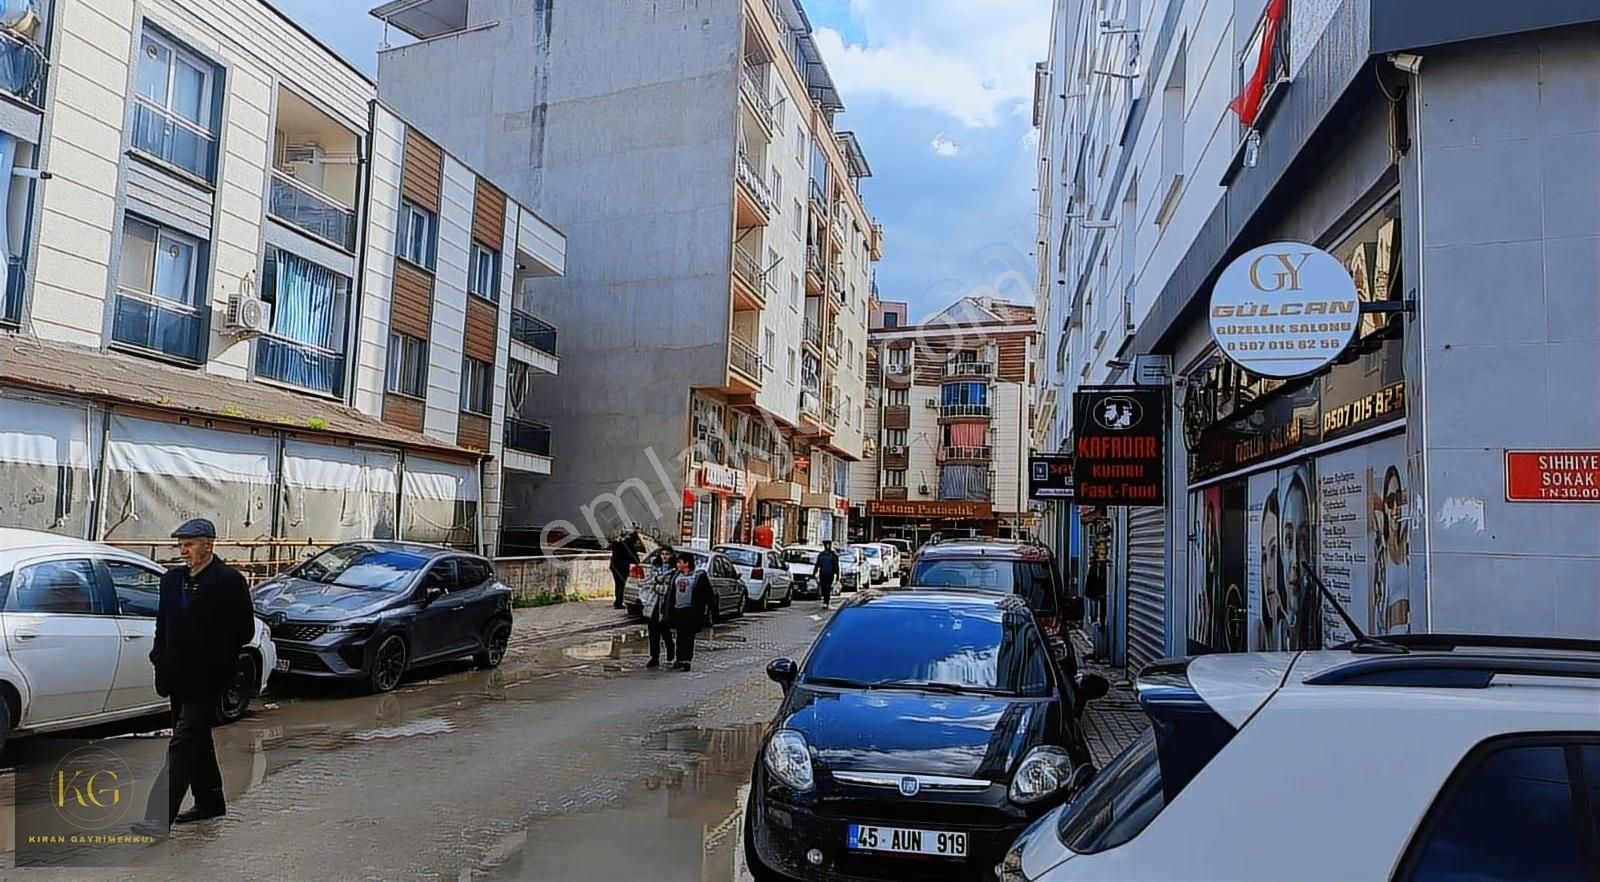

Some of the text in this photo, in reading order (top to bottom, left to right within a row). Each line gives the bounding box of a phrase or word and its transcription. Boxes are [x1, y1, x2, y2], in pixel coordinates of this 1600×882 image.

[1250, 252, 1313, 292] GY
[1211, 301, 1356, 318] GÜLCAN
[1289, 322, 1351, 333] SALONU
[1239, 341, 1265, 350] 507
[1323, 402, 1350, 434] 0507
[1352, 393, 1373, 424] 015
[1093, 463, 1144, 478] KUMRU
[1538, 455, 1599, 470] SIHHIYE
[1542, 471, 1594, 487] SOKAK
[857, 826, 967, 855] 45 AUN 919
